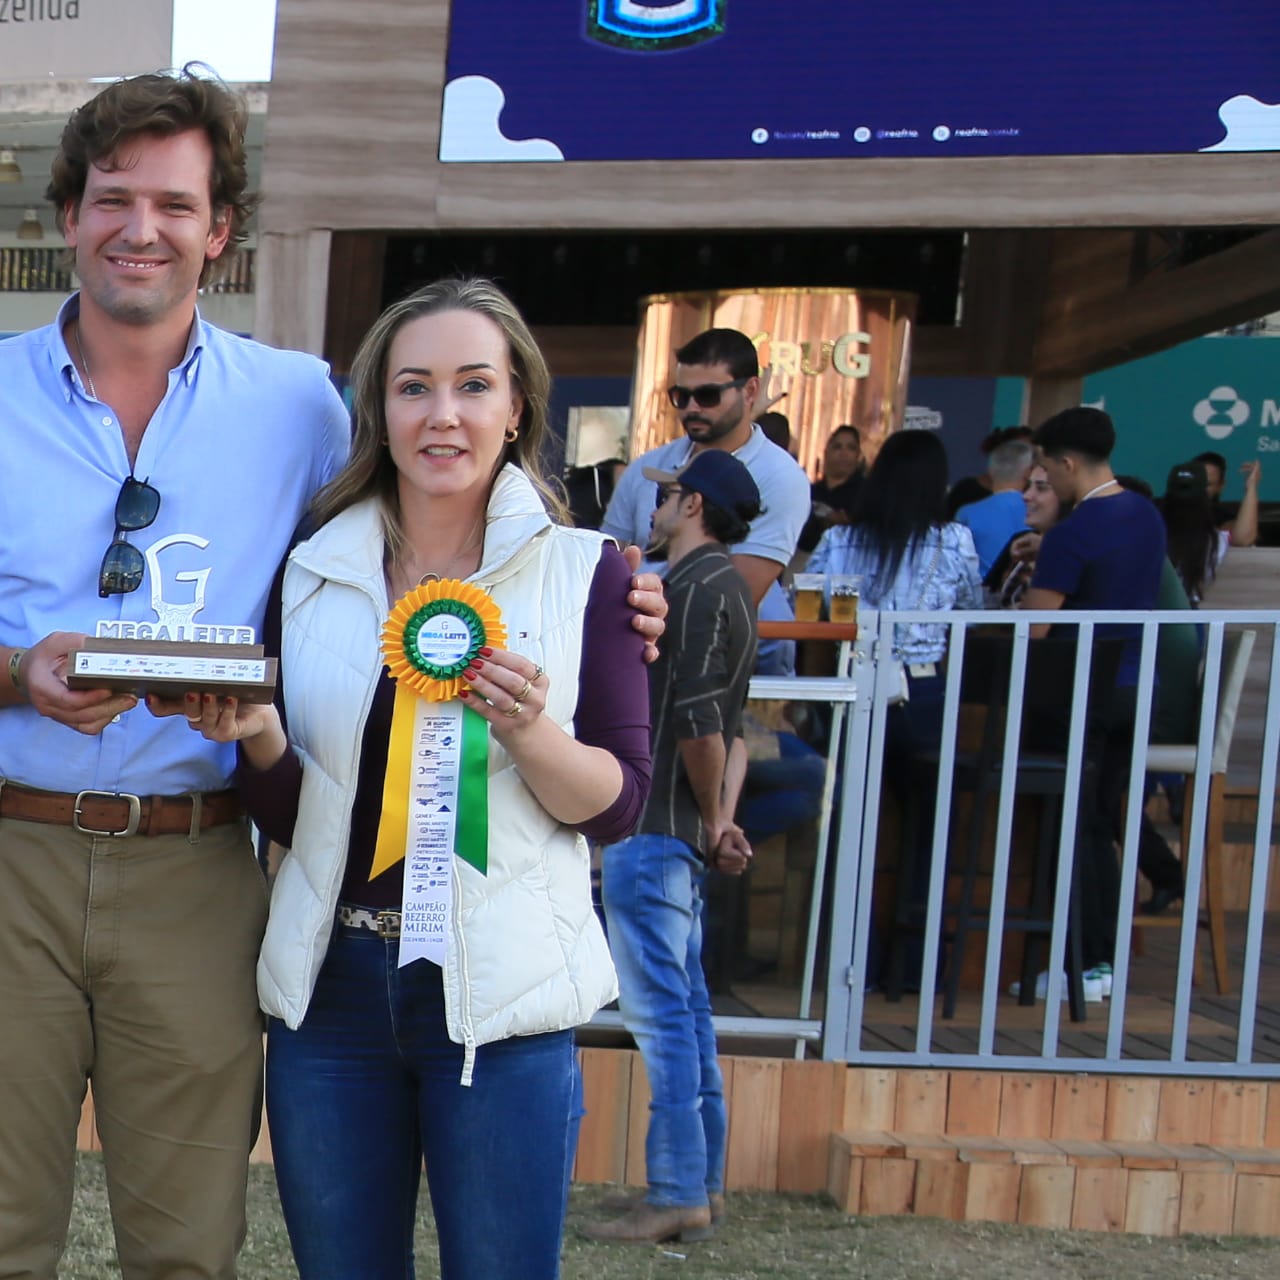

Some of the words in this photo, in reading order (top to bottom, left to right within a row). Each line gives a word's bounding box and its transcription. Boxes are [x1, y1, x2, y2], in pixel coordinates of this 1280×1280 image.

[405, 901, 447, 912] CAMPEÃO
[405, 912, 446, 922] BEZERRO
[404, 922, 444, 933] MIRIM
